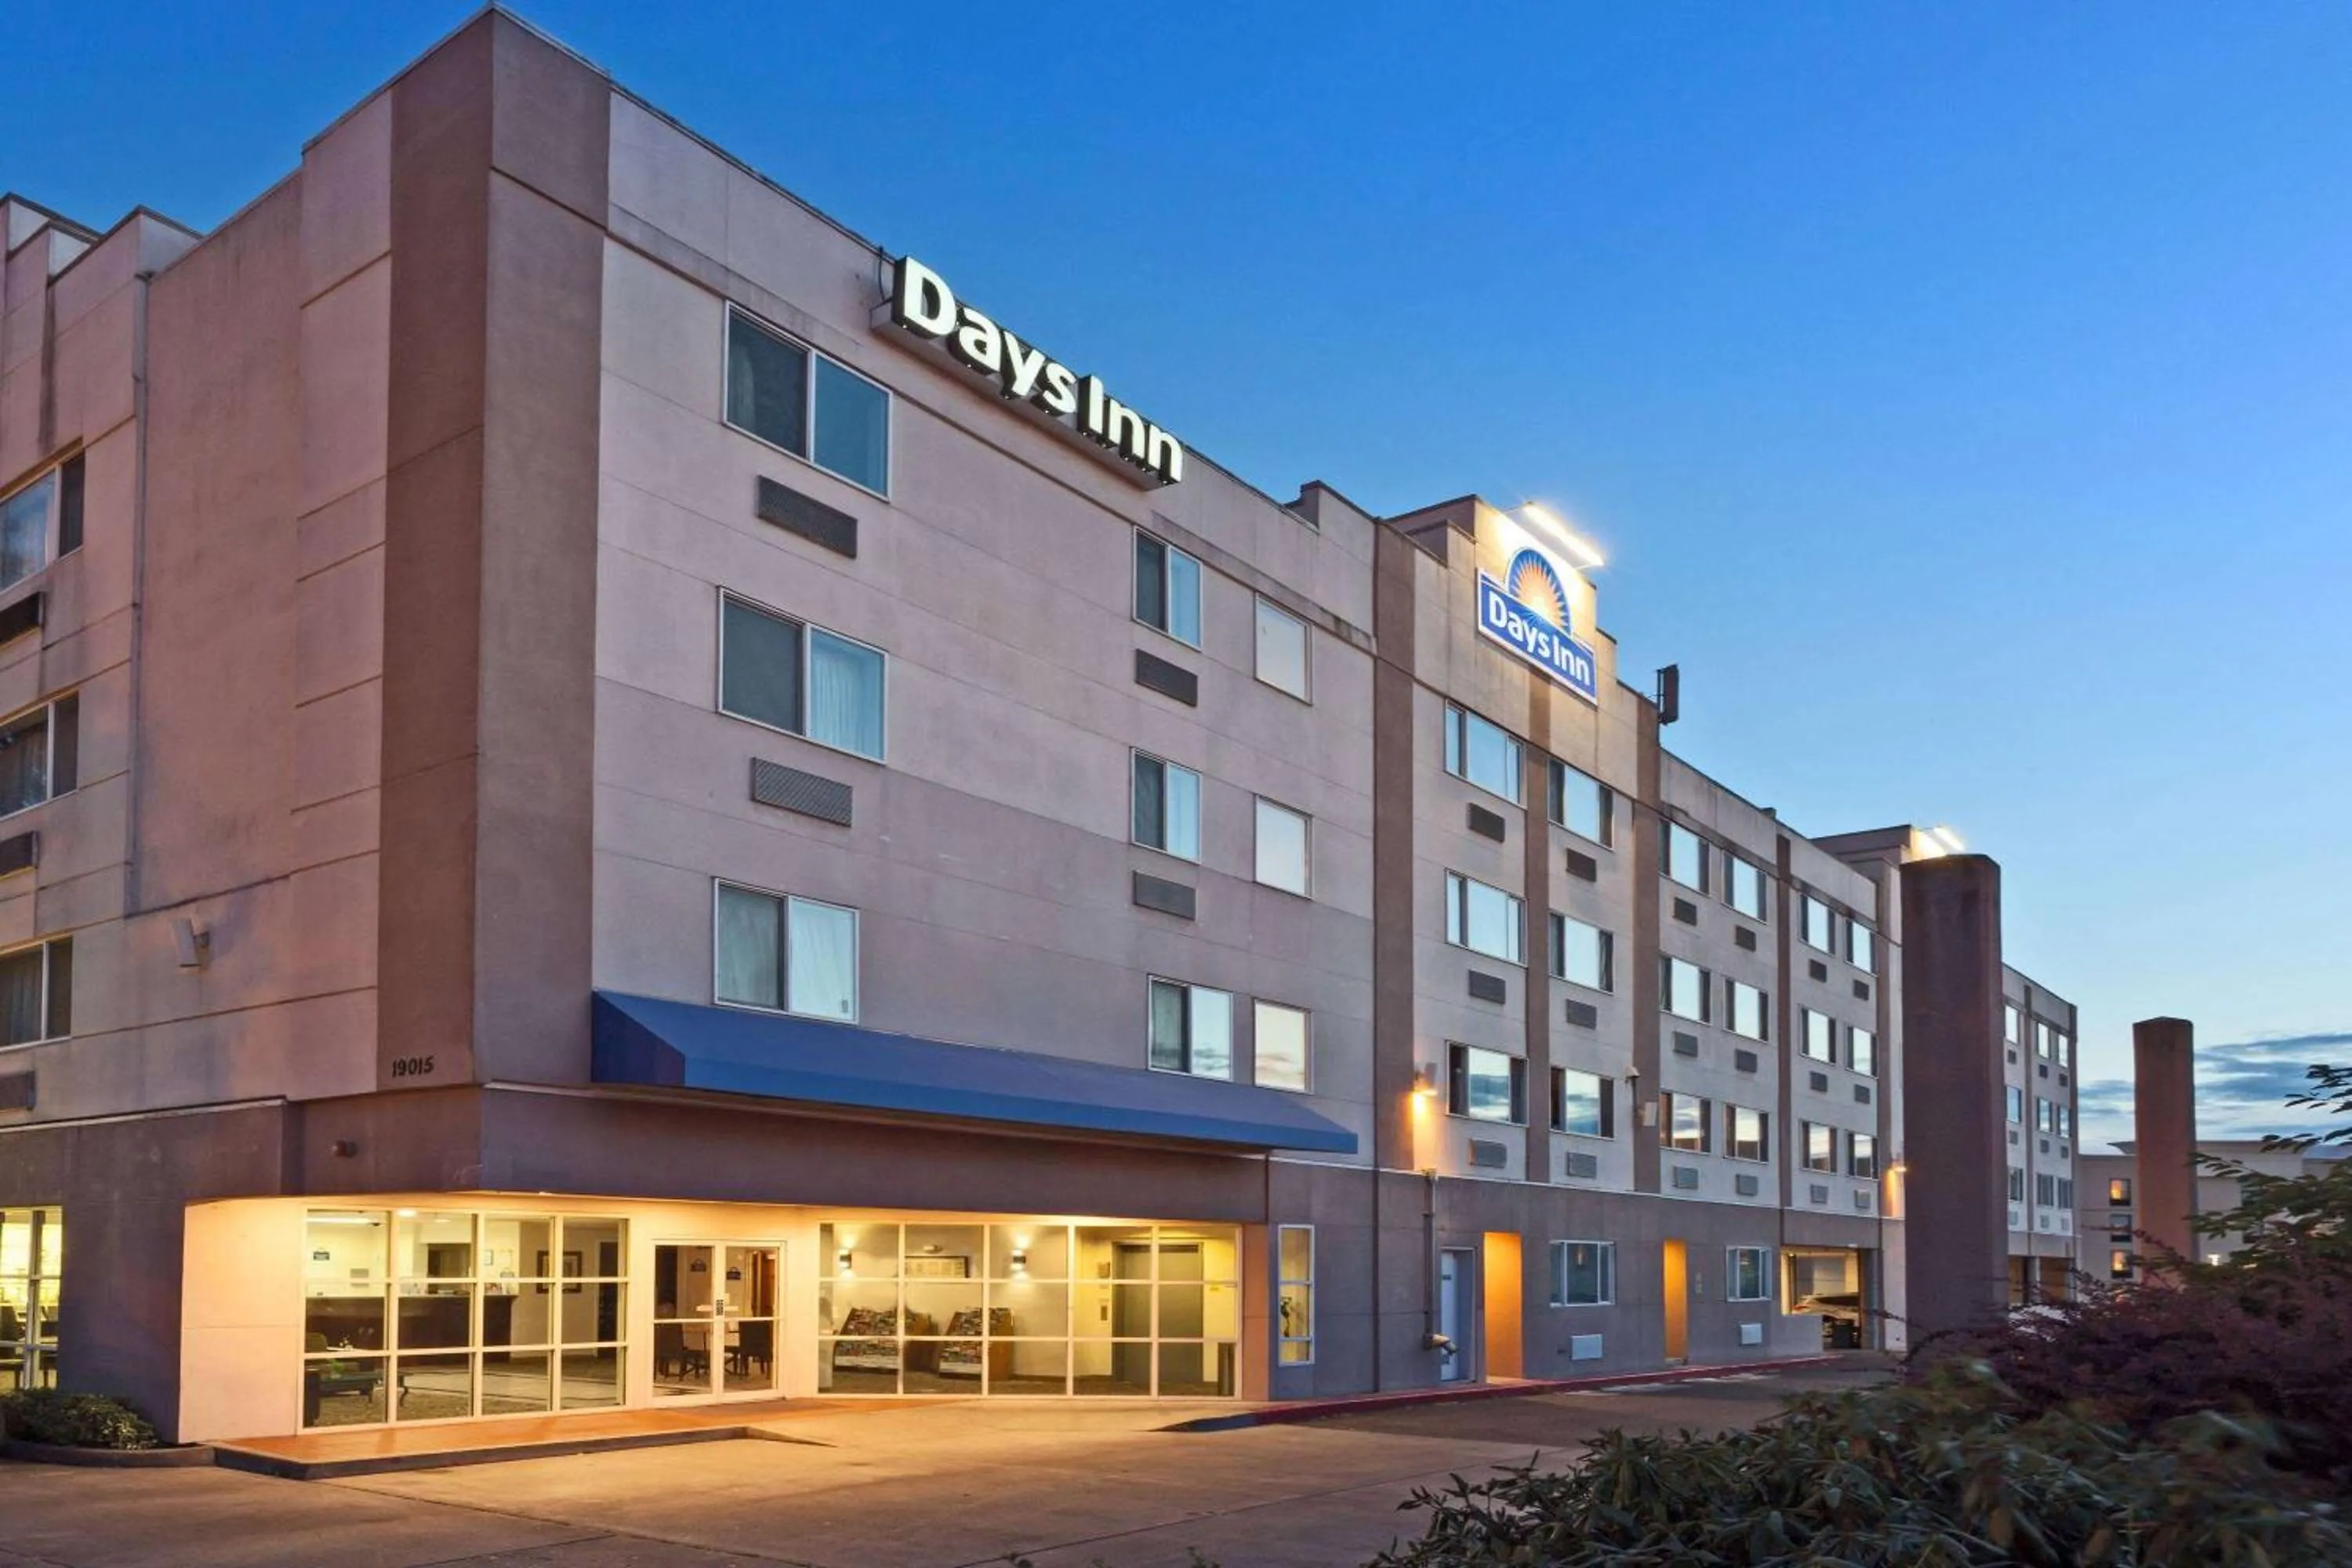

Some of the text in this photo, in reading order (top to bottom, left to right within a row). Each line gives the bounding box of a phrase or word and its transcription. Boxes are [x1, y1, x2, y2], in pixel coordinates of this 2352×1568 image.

[902, 256, 1183, 483] Days Inn
[1489, 590, 1591, 687] Days Inn
[392, 1055, 435, 1077] 19015
